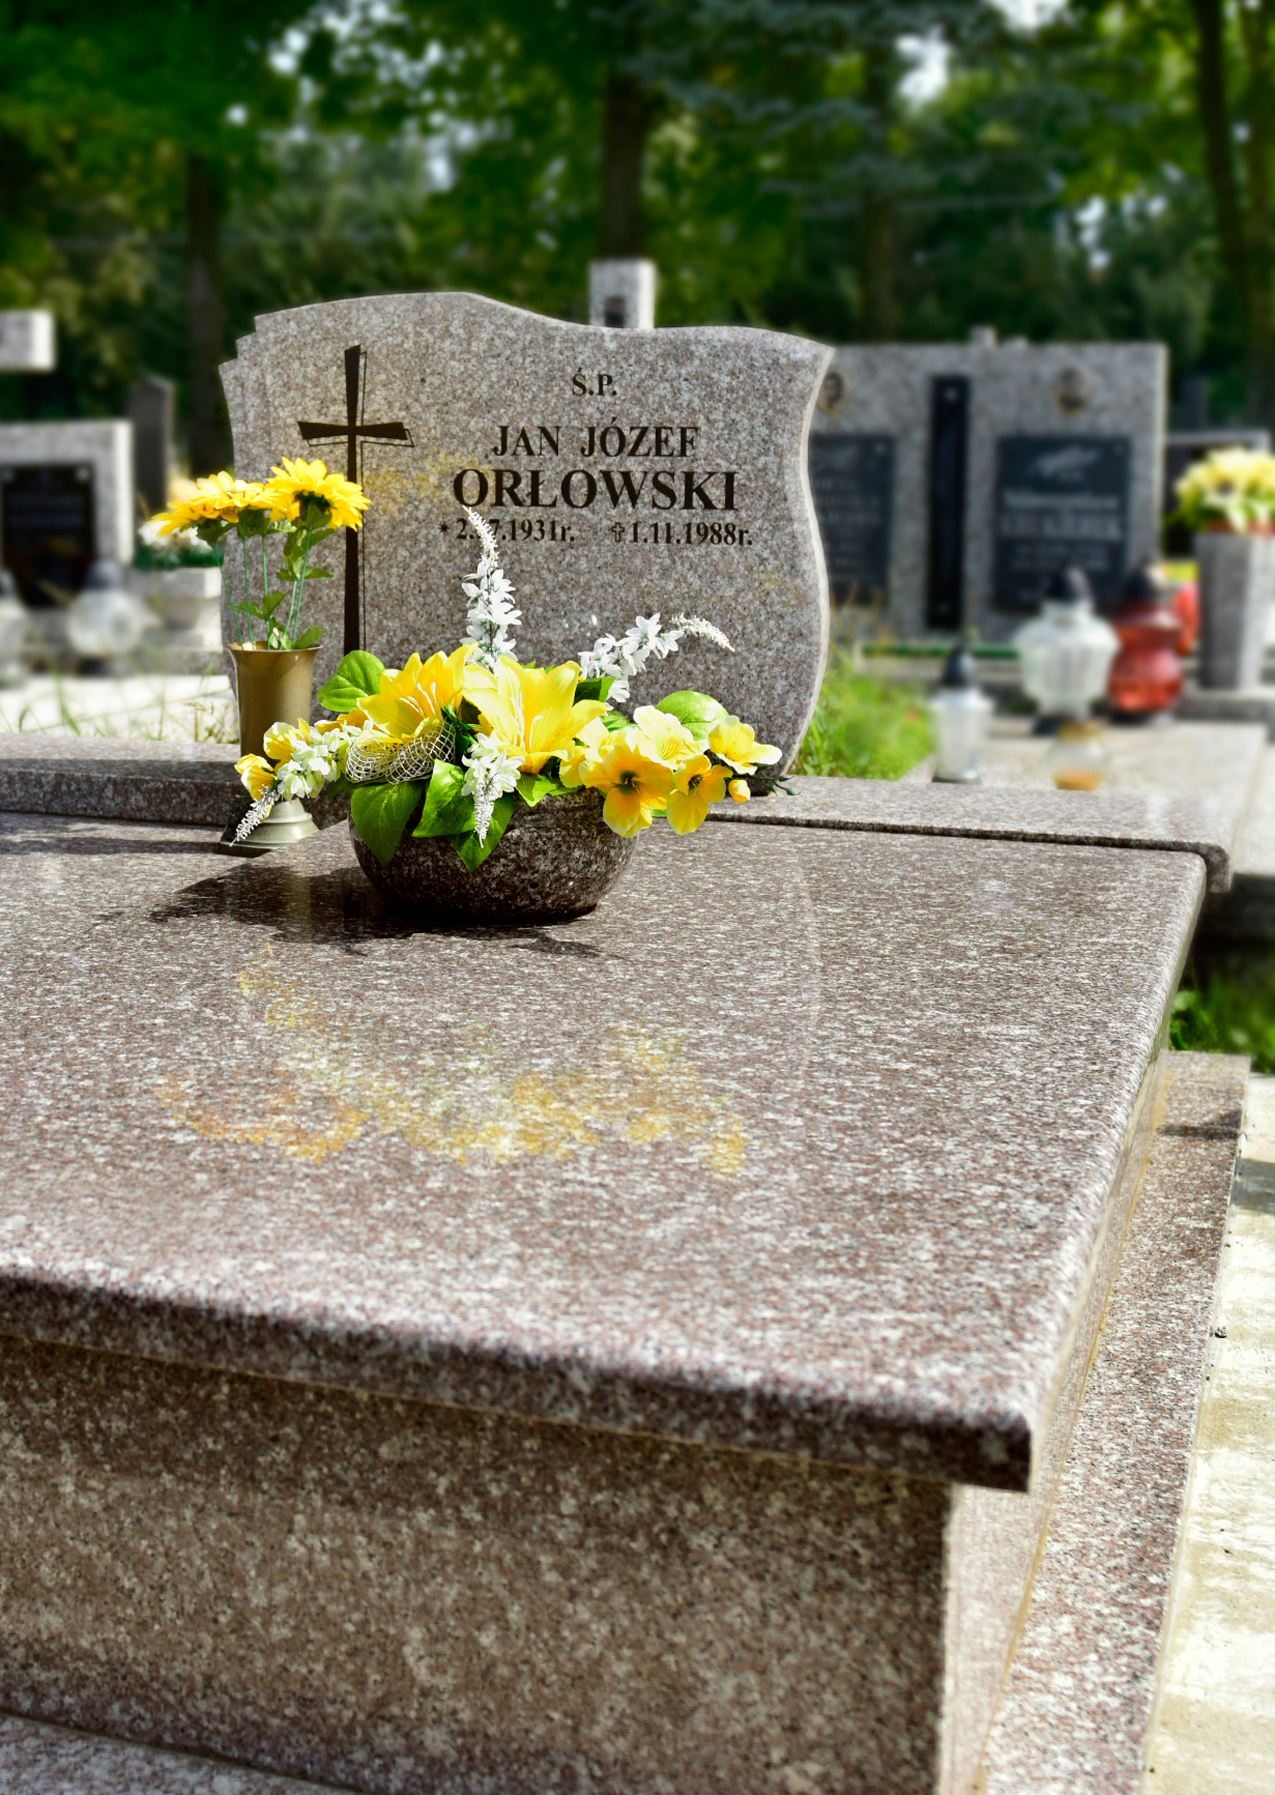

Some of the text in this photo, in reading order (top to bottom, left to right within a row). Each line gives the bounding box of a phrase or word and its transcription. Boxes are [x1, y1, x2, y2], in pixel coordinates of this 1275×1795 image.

[572, 368, 617, 396] Ś.P.
[493, 417, 699, 458] JAN JÓZEF
[453, 468, 738, 511] ORŁOWSKI
[456, 517, 753, 546] 2.7.1931r. 1.11.1988r.
